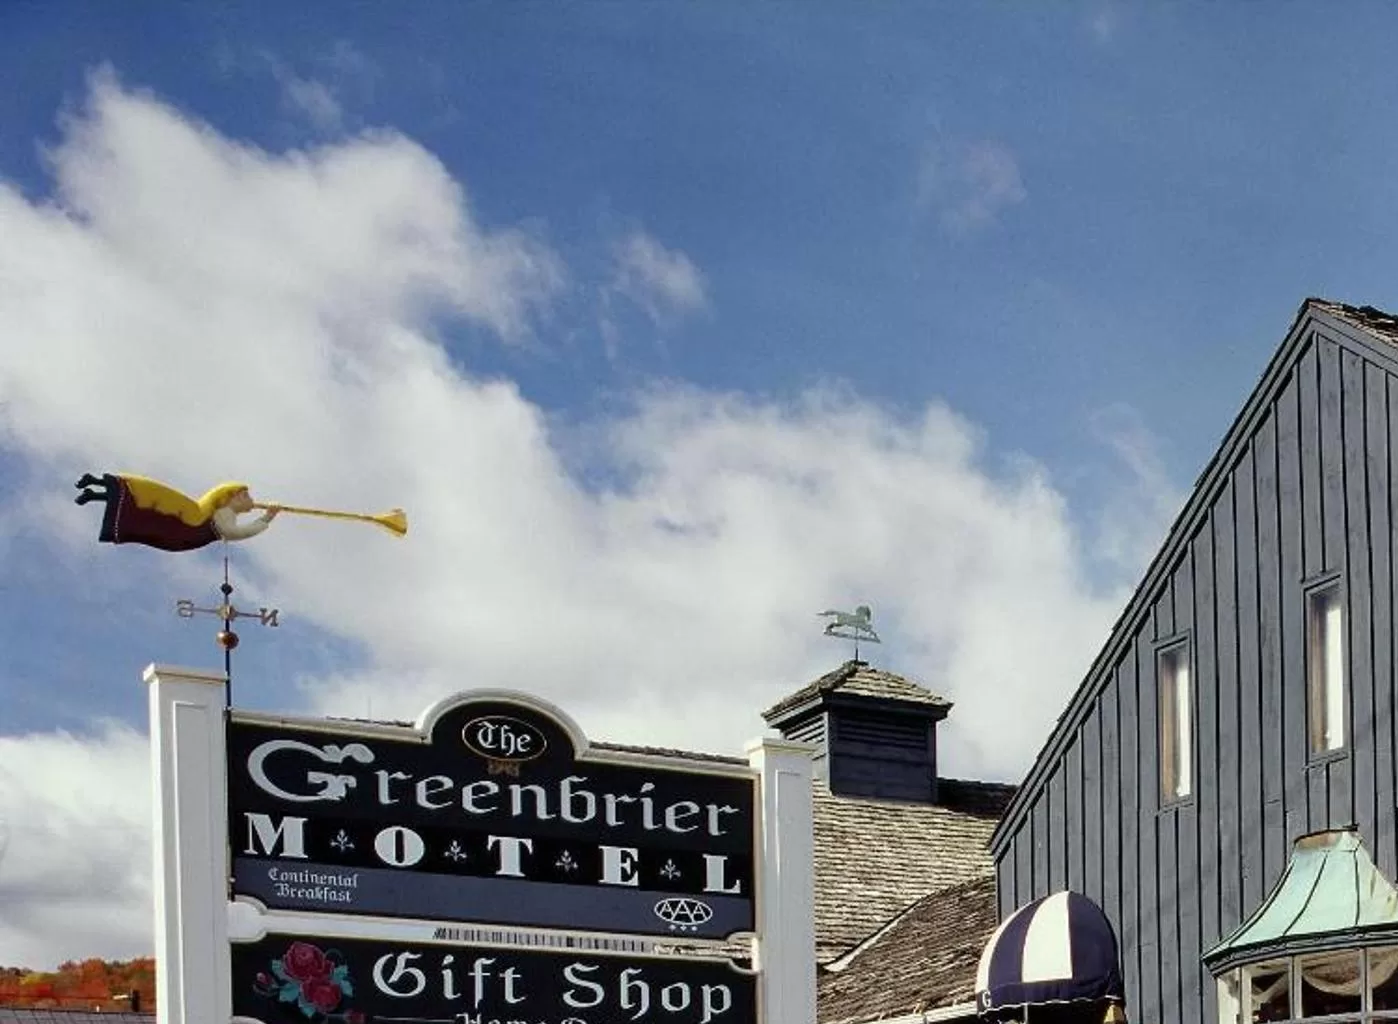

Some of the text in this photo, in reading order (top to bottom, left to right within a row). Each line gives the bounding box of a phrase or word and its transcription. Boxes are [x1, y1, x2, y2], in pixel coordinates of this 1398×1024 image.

[477, 720, 531, 756] The
[246, 739, 741, 837] Greenbrier
[268, 867, 359, 887] Continental
[274, 883, 353, 902] Breakfast
[659, 899, 708, 922] AAA
[372, 951, 732, 1024] Gift Shop
